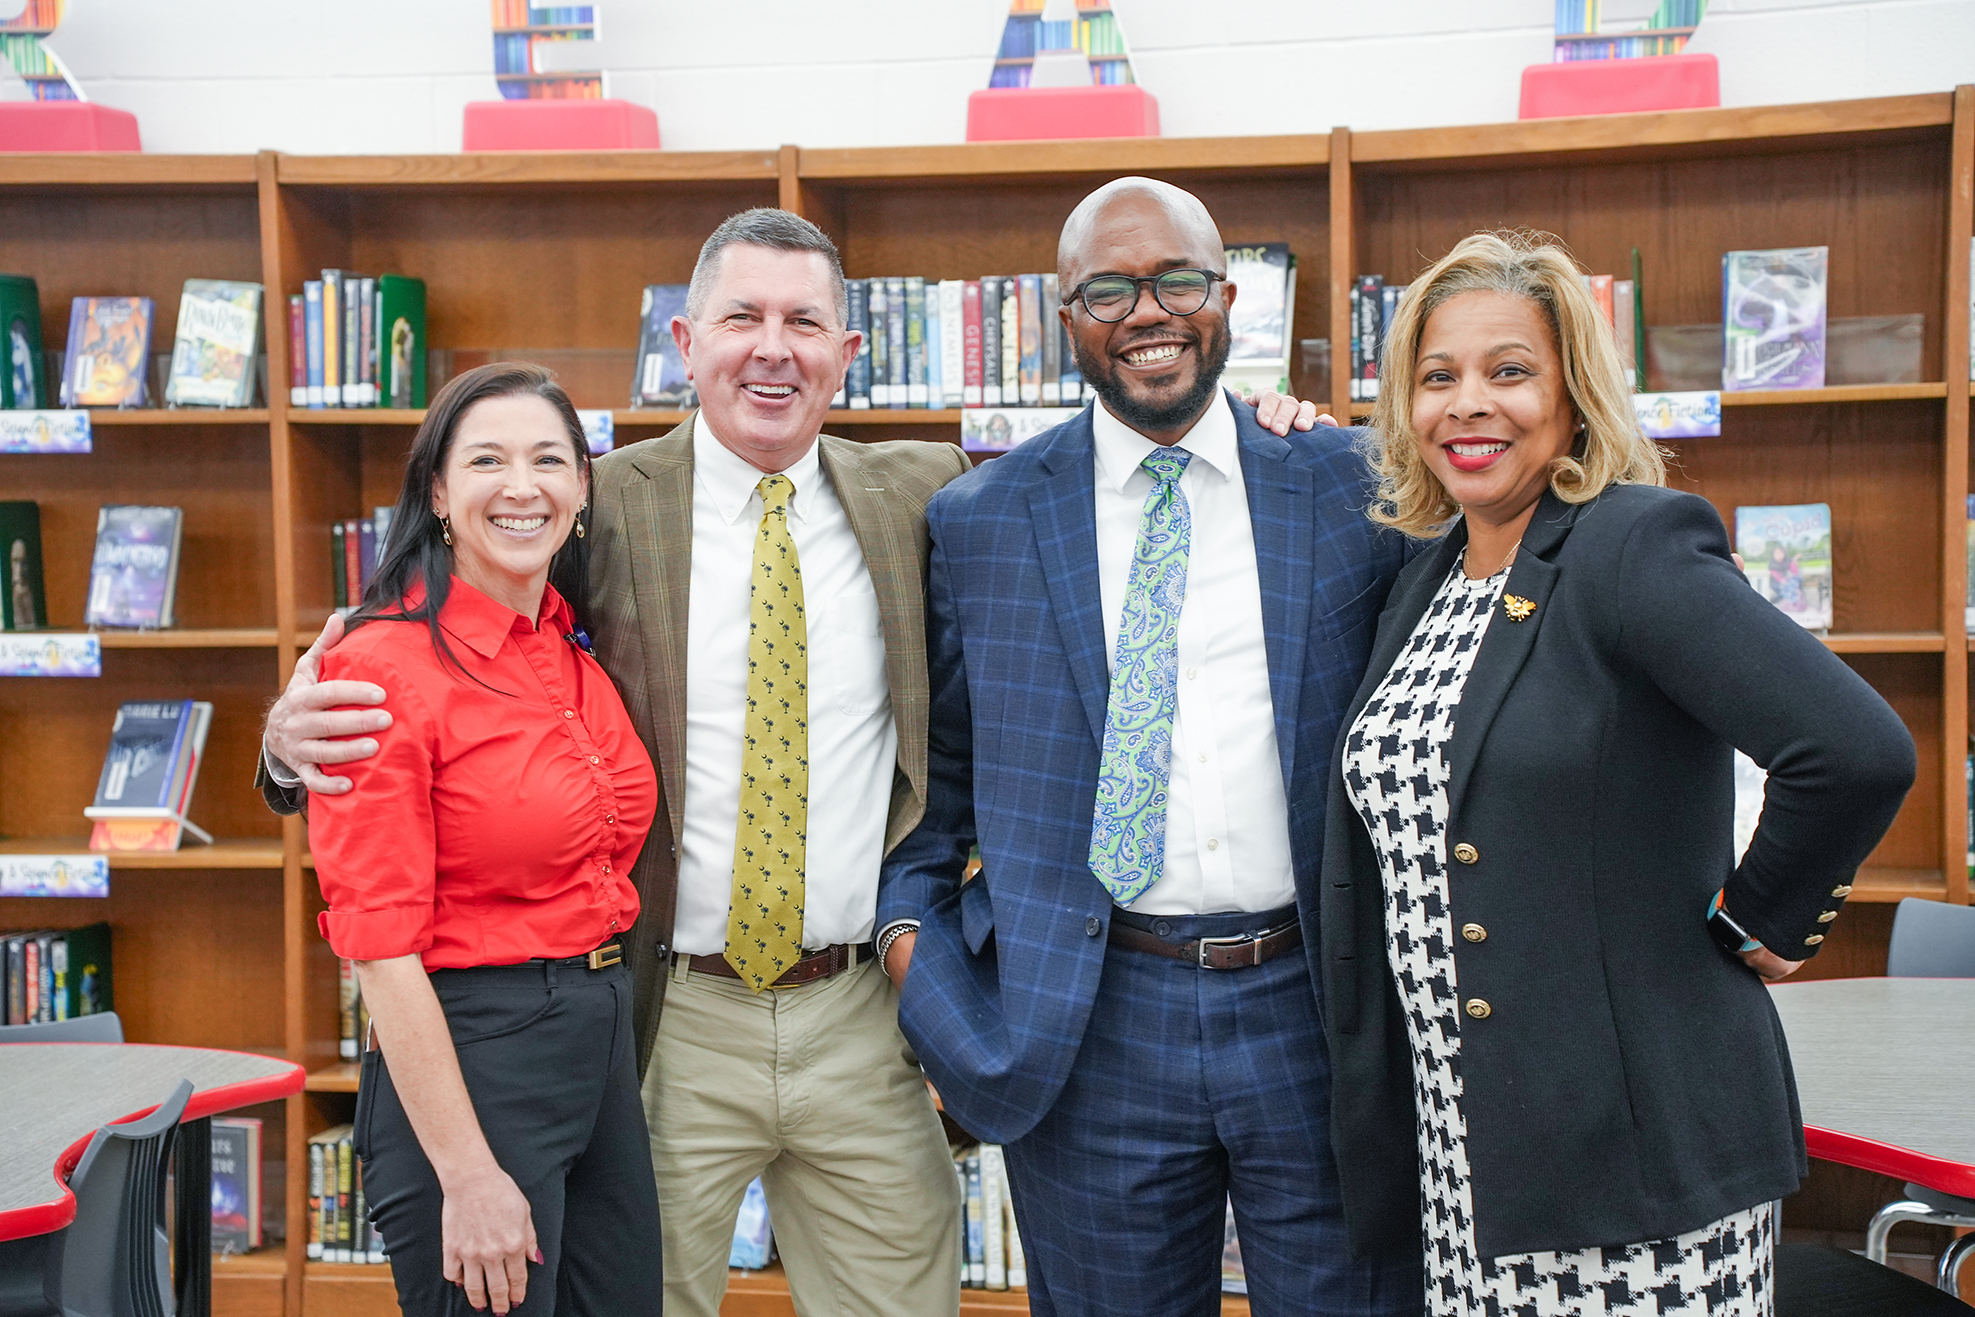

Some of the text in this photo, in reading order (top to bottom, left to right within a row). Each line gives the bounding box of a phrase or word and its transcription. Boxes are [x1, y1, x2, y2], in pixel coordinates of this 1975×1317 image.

[946, 317, 959, 387] NEMESIS
[966, 324, 980, 386] GENESI
[1637, 402, 1711, 418] ence Fiction
